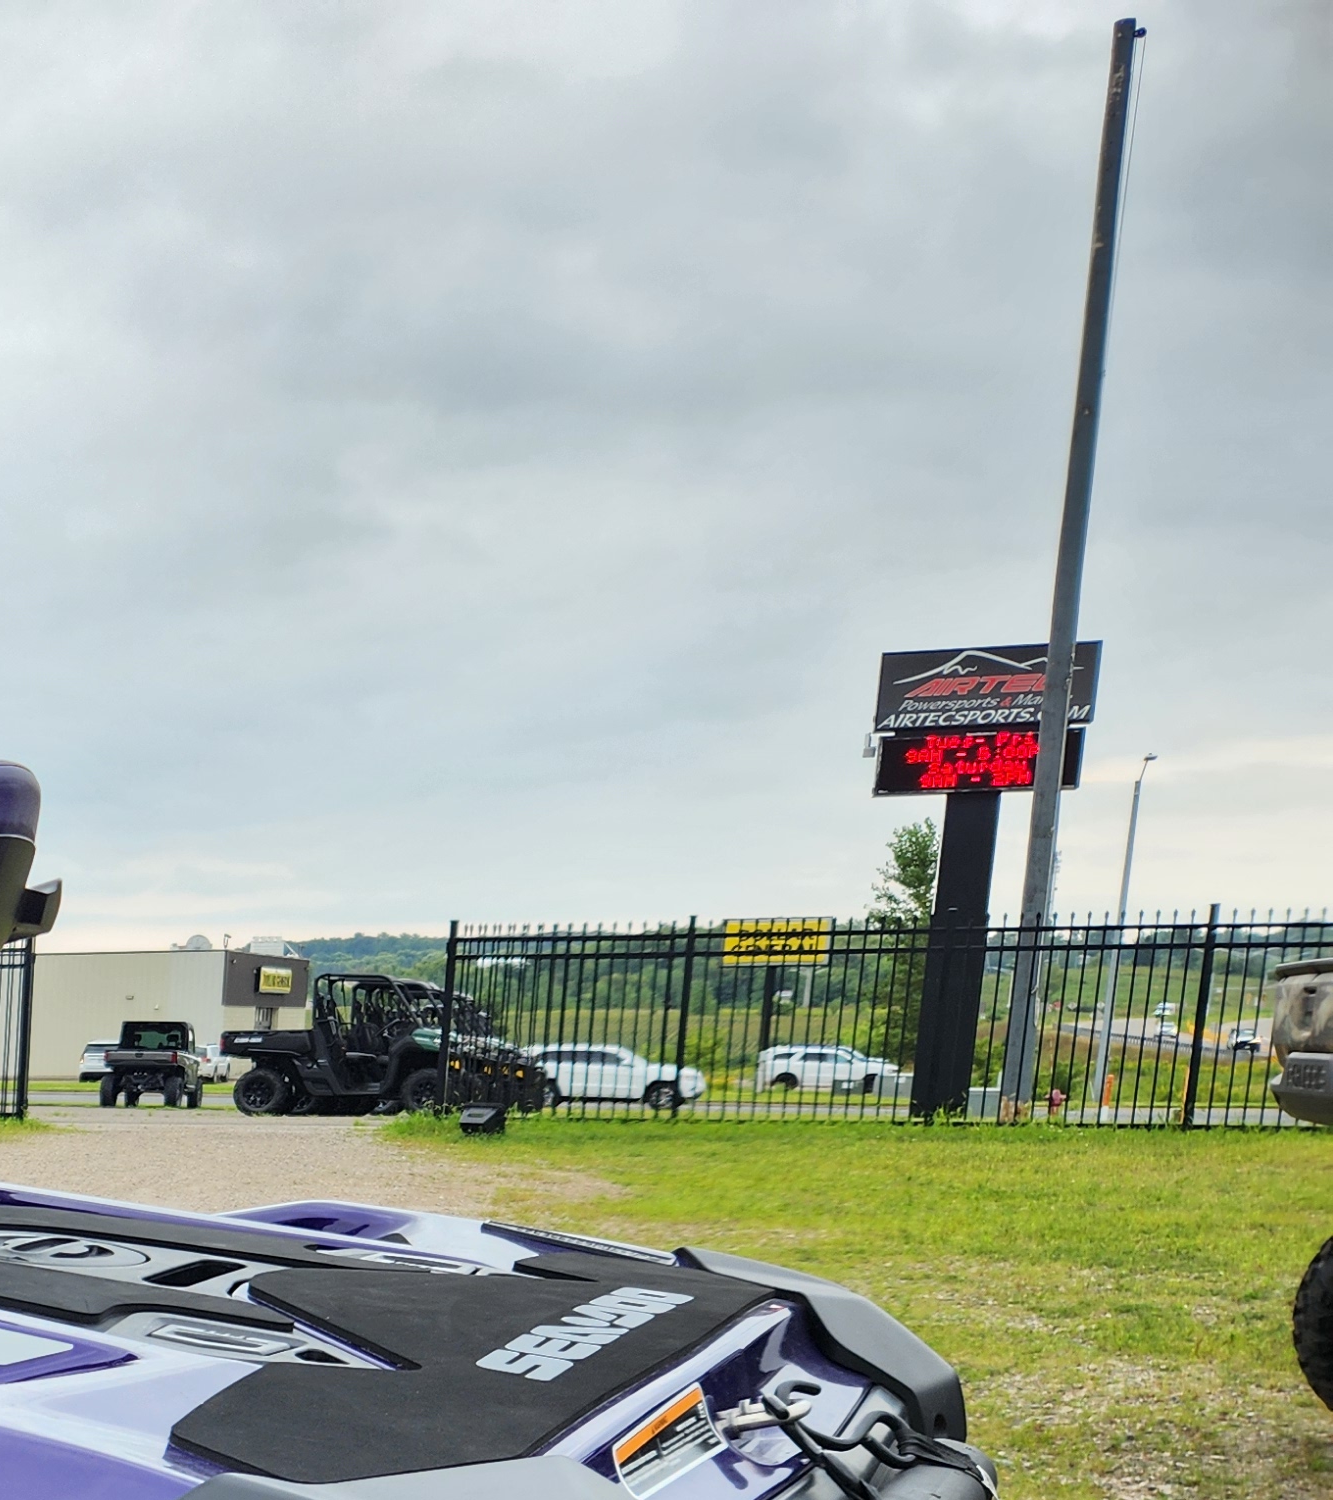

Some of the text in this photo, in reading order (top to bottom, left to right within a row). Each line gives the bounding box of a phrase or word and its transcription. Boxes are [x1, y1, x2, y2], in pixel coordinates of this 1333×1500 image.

[898, 694, 1000, 712] Powersports
[1000, 696, 1012, 707] &
[876, 704, 1092, 730] AIRTECSPORTS.M
